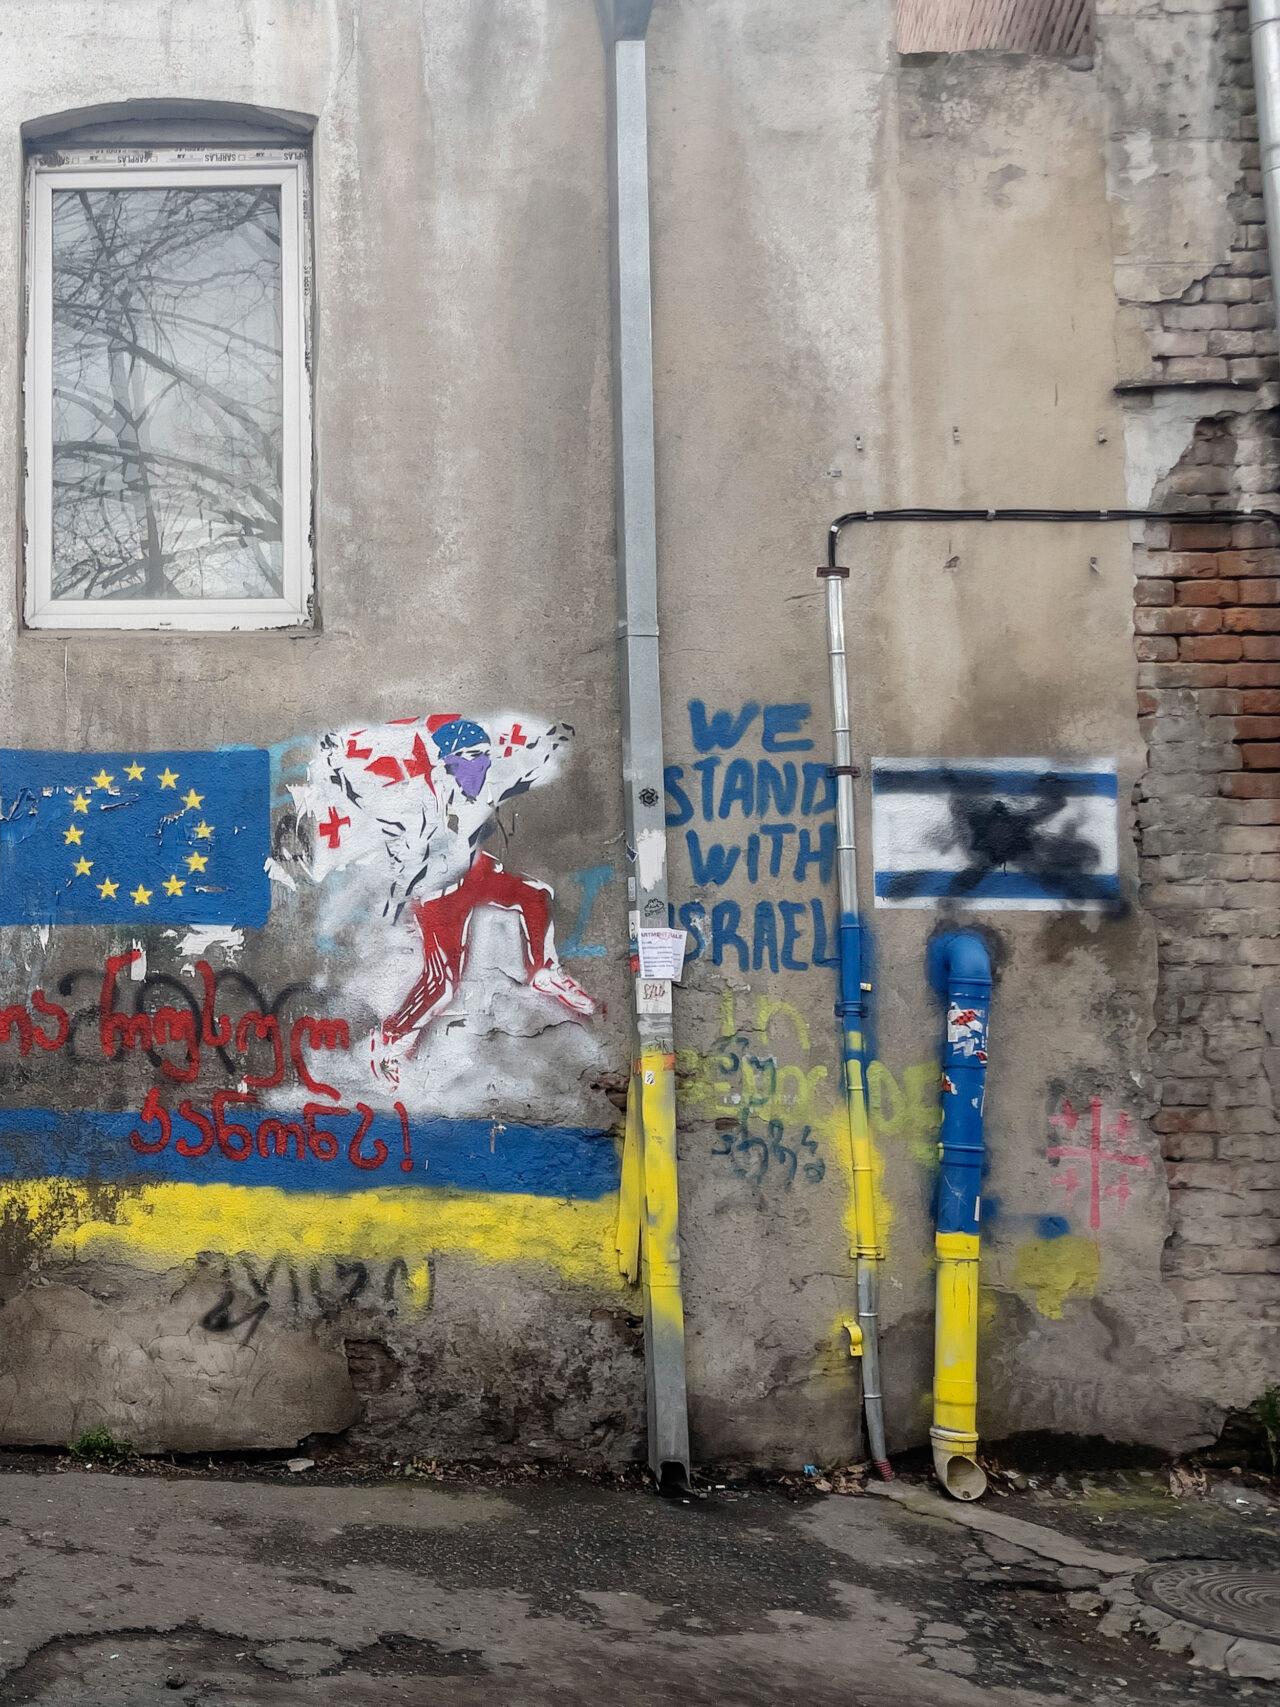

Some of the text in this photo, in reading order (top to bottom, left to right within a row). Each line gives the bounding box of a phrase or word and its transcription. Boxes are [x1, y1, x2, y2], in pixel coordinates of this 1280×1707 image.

[686, 697, 815, 754] WE
[664, 755, 838, 827] STAND
[684, 821, 839, 887] WITH
[667, 896, 842, 974] ISRAEL
[99, 950, 351, 1101] რუსულ
